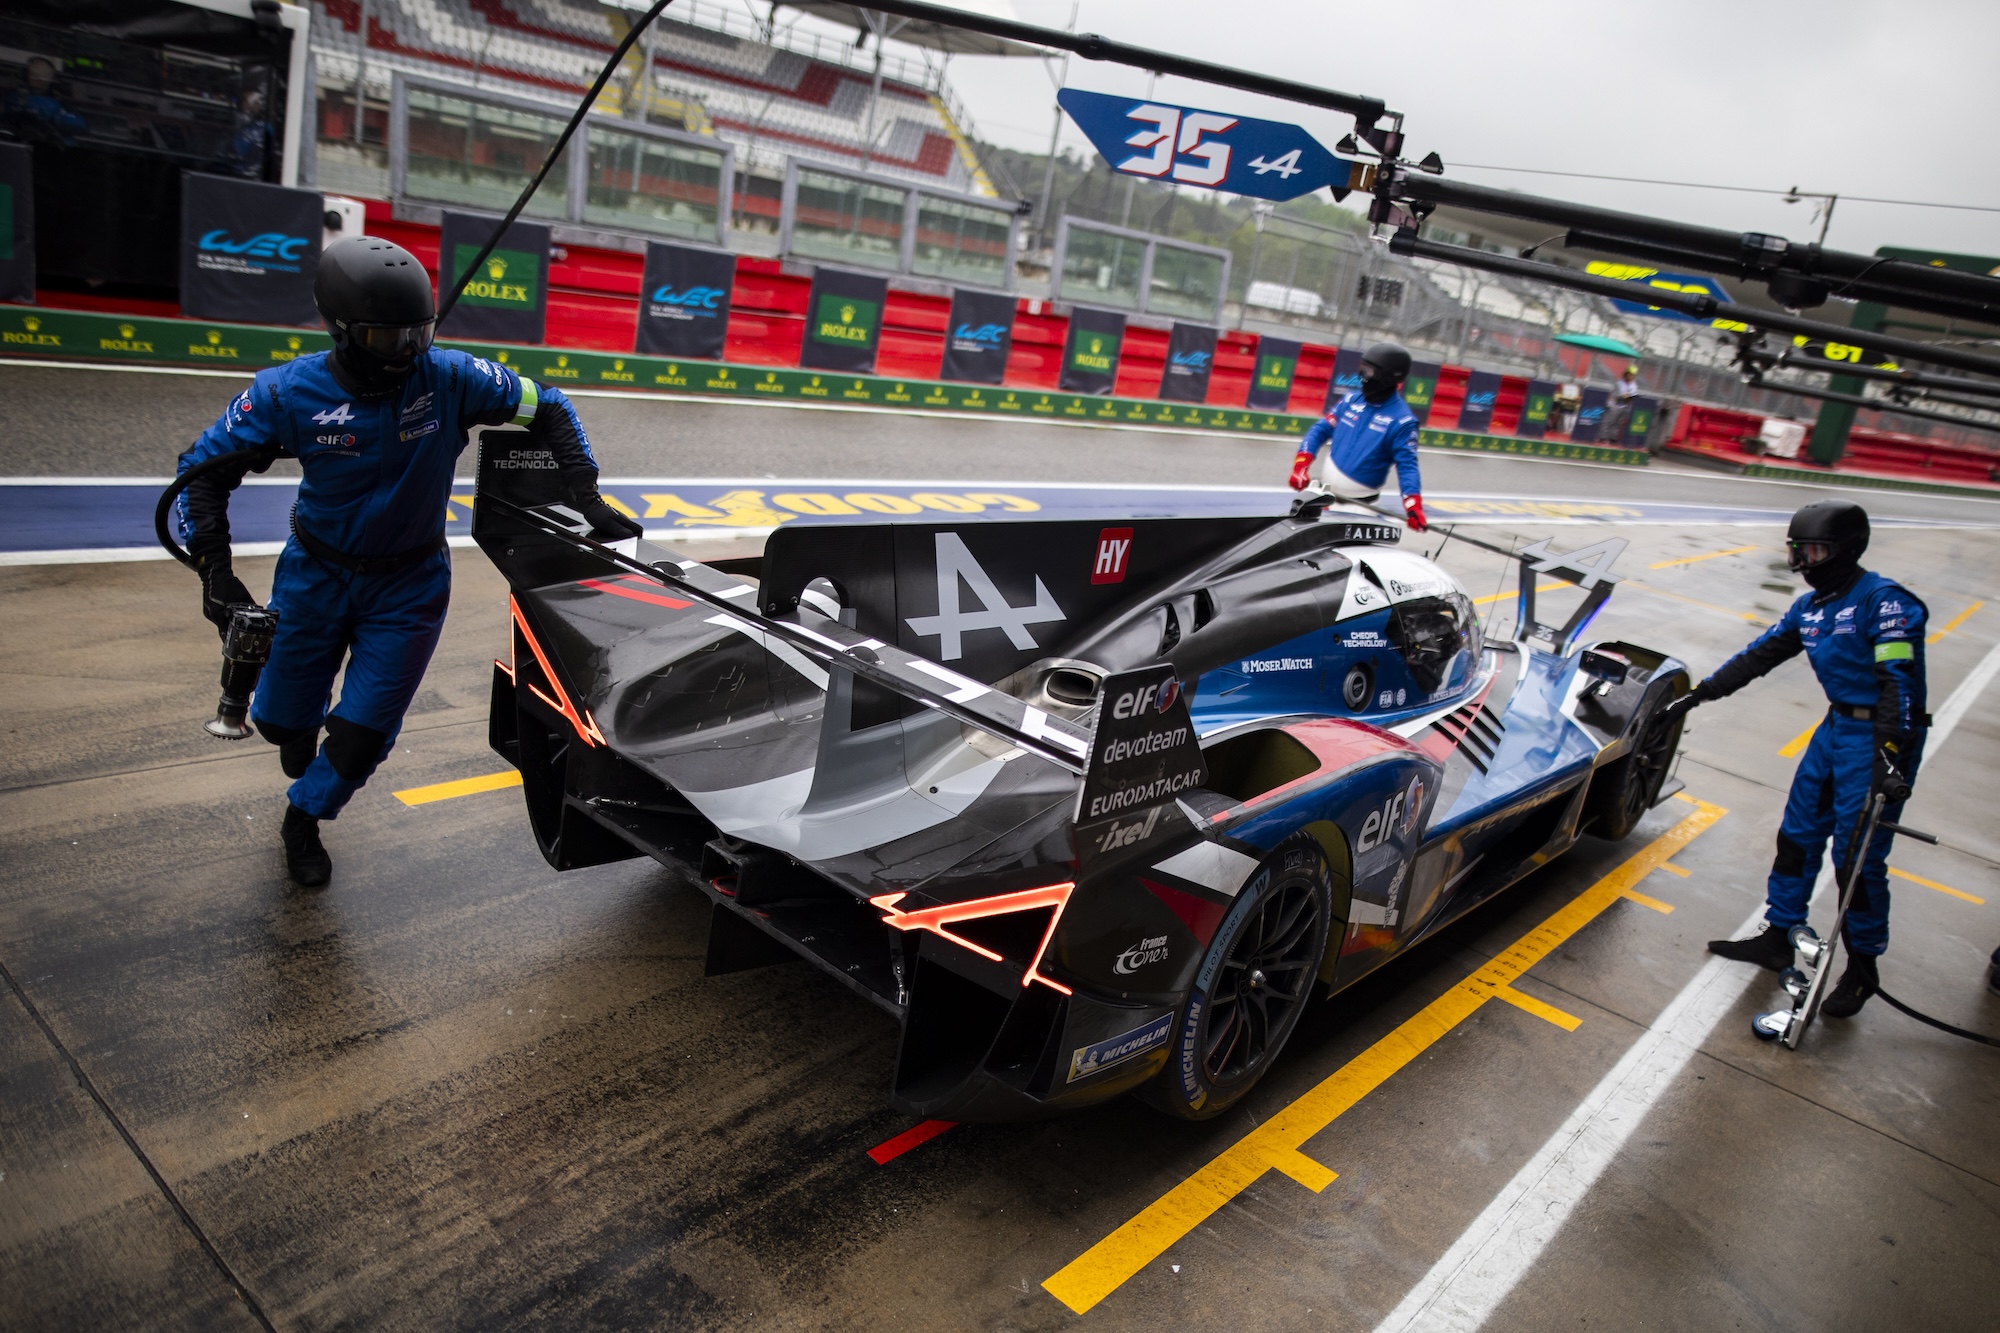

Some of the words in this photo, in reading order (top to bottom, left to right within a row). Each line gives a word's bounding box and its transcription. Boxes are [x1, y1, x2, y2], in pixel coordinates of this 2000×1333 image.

[1117, 103, 1240, 187] 35
[199, 229, 309, 261] WEC
[462, 281, 527, 302] ROLEX
[653, 284, 725, 309] WEC
[3, 332, 61, 347] ROLEX
[820, 323, 868, 341] ROLEX
[954, 323, 1008, 342] WEC
[101, 338, 154, 353] ROLEX
[189, 344, 239, 359] ROLEX
[1075, 353, 1110, 369] ROLEX
[543, 367, 579, 379] ROLEX
[601, 371, 635, 382] ROLEX
[655, 375, 687, 386] ROLEX
[706, 379, 737, 390] ROLEX
[316, 434, 341, 446] elf
[493, 460, 560, 470] TECHNOLO
[1352, 527, 1400, 540] ALTEN
[1095, 539, 1130, 575] HY
[1879, 618, 1897, 630] elf
[1350, 632, 1379, 640] CHEOPS
[1535, 625, 1554, 642] 35
[1343, 639, 1388, 648] TECHNOLOGY
[1113, 684, 1158, 720] elf
[1103, 727, 1188, 764] devoteam
[1090, 768, 1201, 817] EURODATACAR
[1100, 806, 1162, 853] ixell
[1357, 791, 1405, 853] elf
[1140, 935, 1168, 951] France
[1203, 949, 1220, 983] PILOT
[1219, 912, 1240, 948] SPORT
[1101, 1023, 1169, 1063] MICHELIN
[1182, 1001, 1202, 1094] MICHELIN
